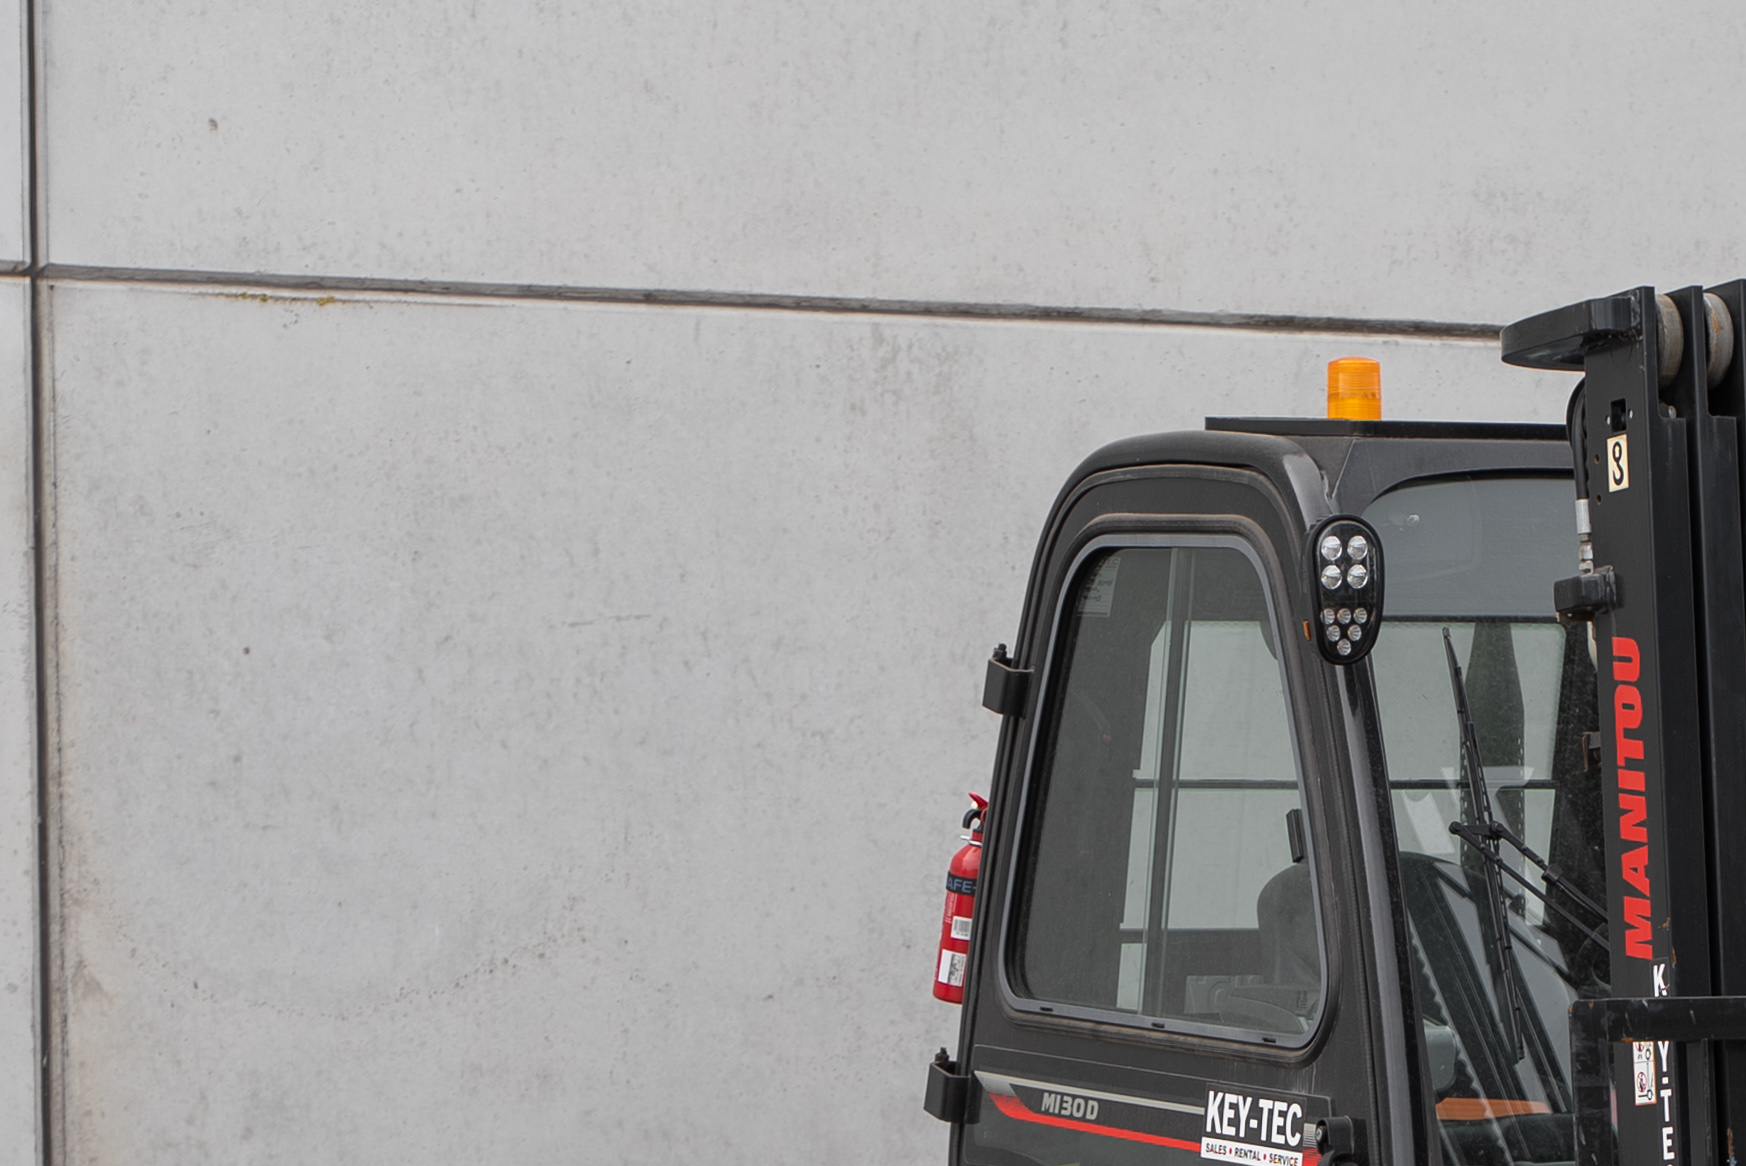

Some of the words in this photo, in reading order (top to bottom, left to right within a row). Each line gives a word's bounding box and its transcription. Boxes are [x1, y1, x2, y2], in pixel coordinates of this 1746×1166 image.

[1612, 636, 1653, 960] MANITOU
[1206, 1090, 1302, 1147] KEY-TEC
[1205, 1142, 1227, 1156] SALES
[1234, 1147, 1261, 1161] RENTAL
